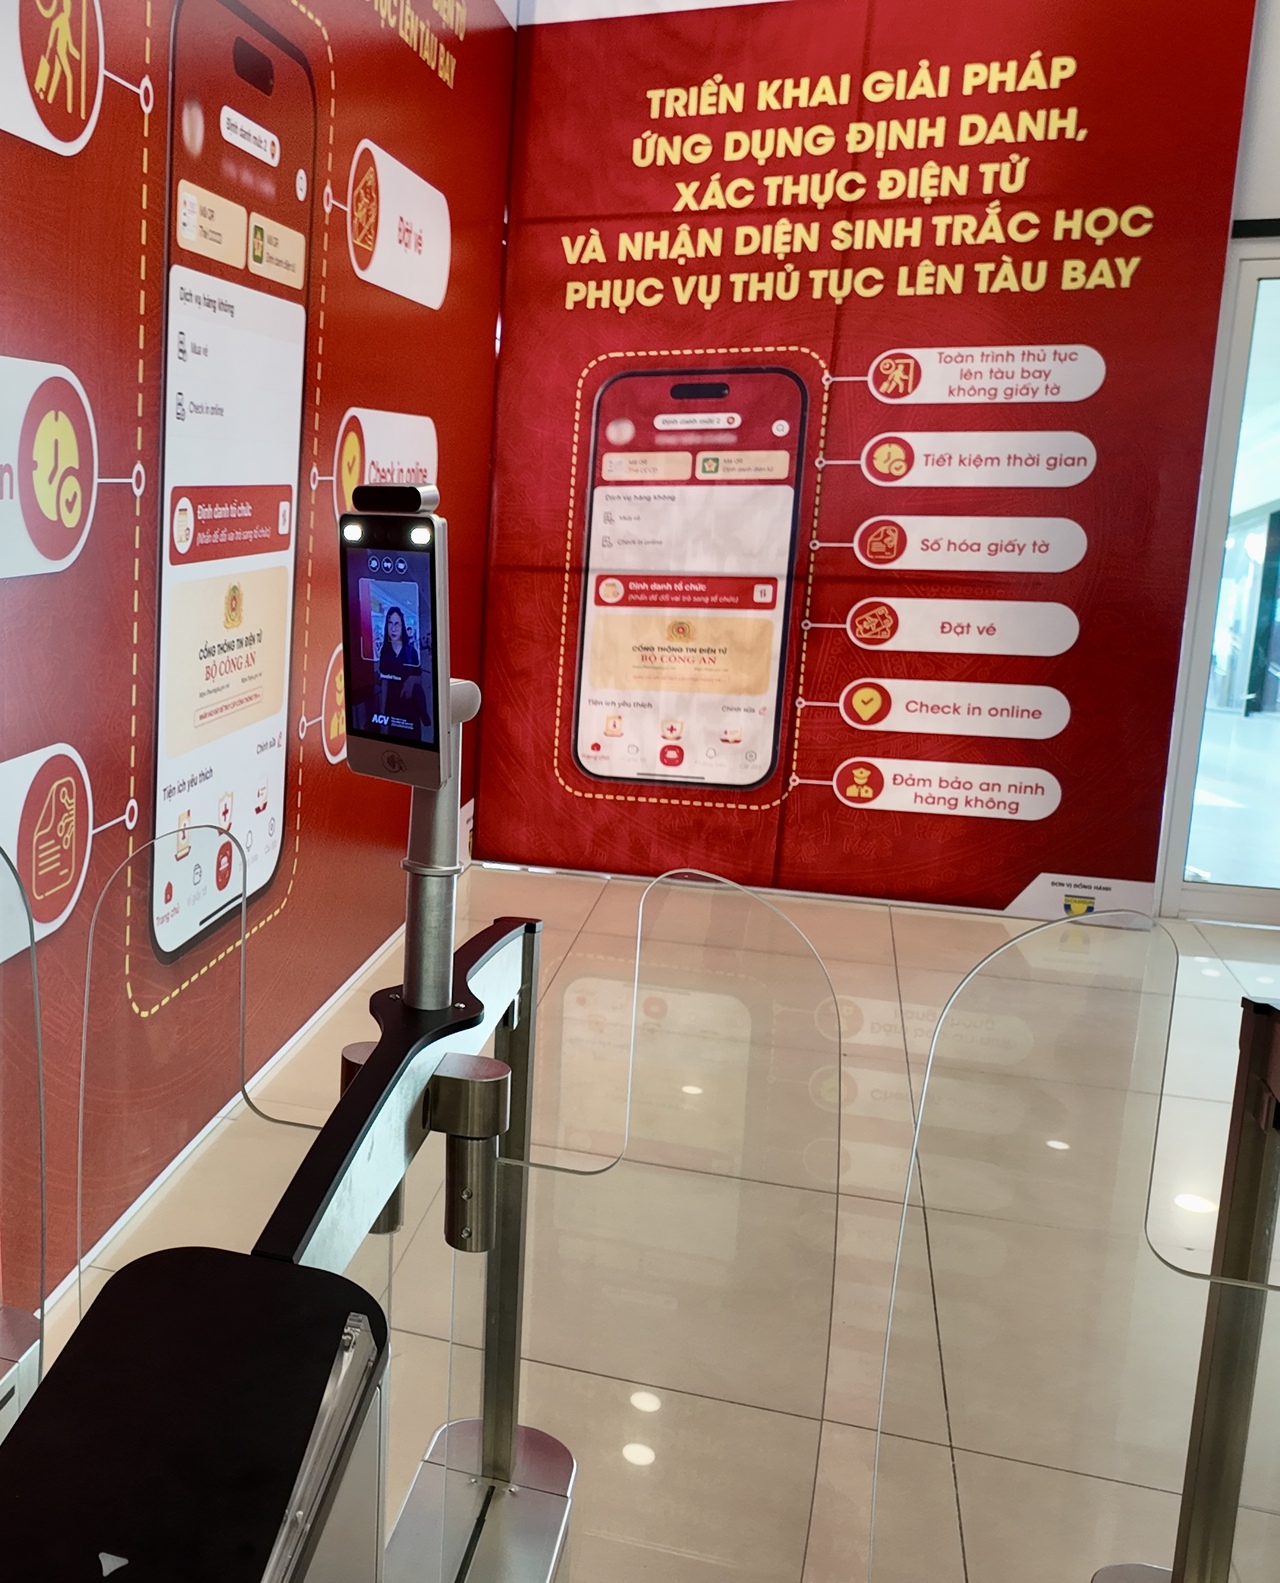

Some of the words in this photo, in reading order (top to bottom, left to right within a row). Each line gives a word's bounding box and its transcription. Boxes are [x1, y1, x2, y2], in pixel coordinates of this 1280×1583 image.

[646, 73, 744, 119] TRIỂN
[757, 74, 851, 110] KHAI
[861, 58, 950, 103] GIẢI
[962, 50, 1077, 95] PHÁP
[631, 128, 713, 167] ỨNG
[723, 124, 835, 167] DỤNG
[845, 116, 947, 160] ĐỊNH
[958, 106, 1089, 146] DANH,
[672, 173, 754, 213] XÁC
[763, 169, 867, 210] THỰC
[877, 160, 969, 204] ĐIỆN
[979, 152, 1031, 195] TỬ
[561, 228, 606, 265] VÀ
[618, 222, 723, 266] NHẬN
[734, 217, 820, 261] DIỆN
[830, 216, 922, 252] SINH
[931, 199, 1040, 246] TRẮC
[1053, 204, 1155, 246] HỌC
[564, 280, 664, 314] PHỤC
[672, 276, 721, 311] VỤ
[729, 262, 801, 303] THỦ
[809, 265, 885, 305] TỤC
[896, 258, 964, 297] LÊN
[974, 254, 1048, 293] TÀU
[1061, 255, 1142, 291] BAY
[937, 350, 976, 364] Toàn
[980, 349, 1015, 363] trình
[1020, 347, 1047, 363] thủ
[1052, 350, 1079, 366] tục
[959, 367, 984, 381] lên
[989, 367, 1015, 381] tàu
[1020, 367, 1052, 385] bay
[947, 385, 998, 400] không
[1002, 382, 1038, 400] giấy
[1042, 384, 1061, 397] tờ
[922, 453, 954, 468] Tiết
[958, 454, 1001, 470] kiệm
[1006, 453, 1040, 468] thời
[1045, 454, 1088, 471] gian
[920, 538, 943, 552] Số
[947, 538, 982, 553] hóa
[987, 538, 1026, 556] giấy
[1031, 540, 1050, 554] tờ
[939, 620, 971, 638] Đặt
[976, 621, 996, 637] vé
[372, 714, 389, 725] ACV
[905, 700, 961, 717] Check
[967, 702, 982, 717] in
[988, 704, 1043, 721] online
[892, 773, 932, 789] Đảm
[938, 776, 973, 791] bảo
[980, 781, 1002, 792] an
[1007, 780, 1045, 796] ninh
[913, 792, 959, 810] hàng
[964, 795, 1020, 815] không
